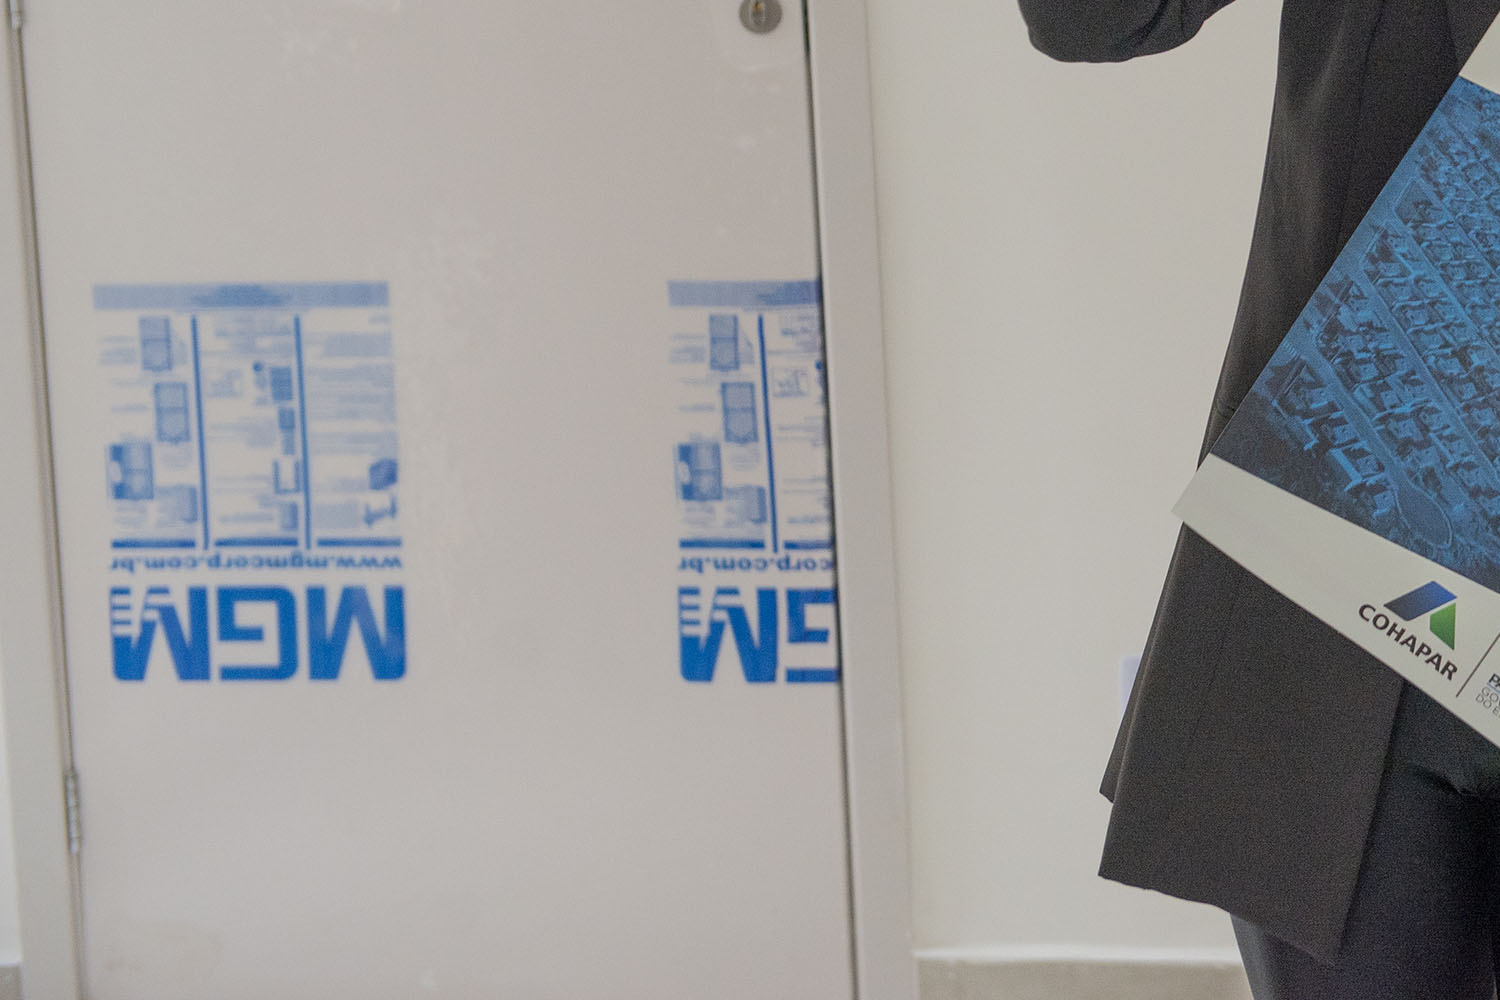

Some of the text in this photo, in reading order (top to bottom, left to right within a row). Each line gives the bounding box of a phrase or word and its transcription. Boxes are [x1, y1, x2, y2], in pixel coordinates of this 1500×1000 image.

[110, 551, 403, 574] www.mgmcorp.com.br
[109, 585, 407, 682] MGM
[1358, 603, 1458, 681] COHAPAR
[1475, 693, 1492, 709] DO
